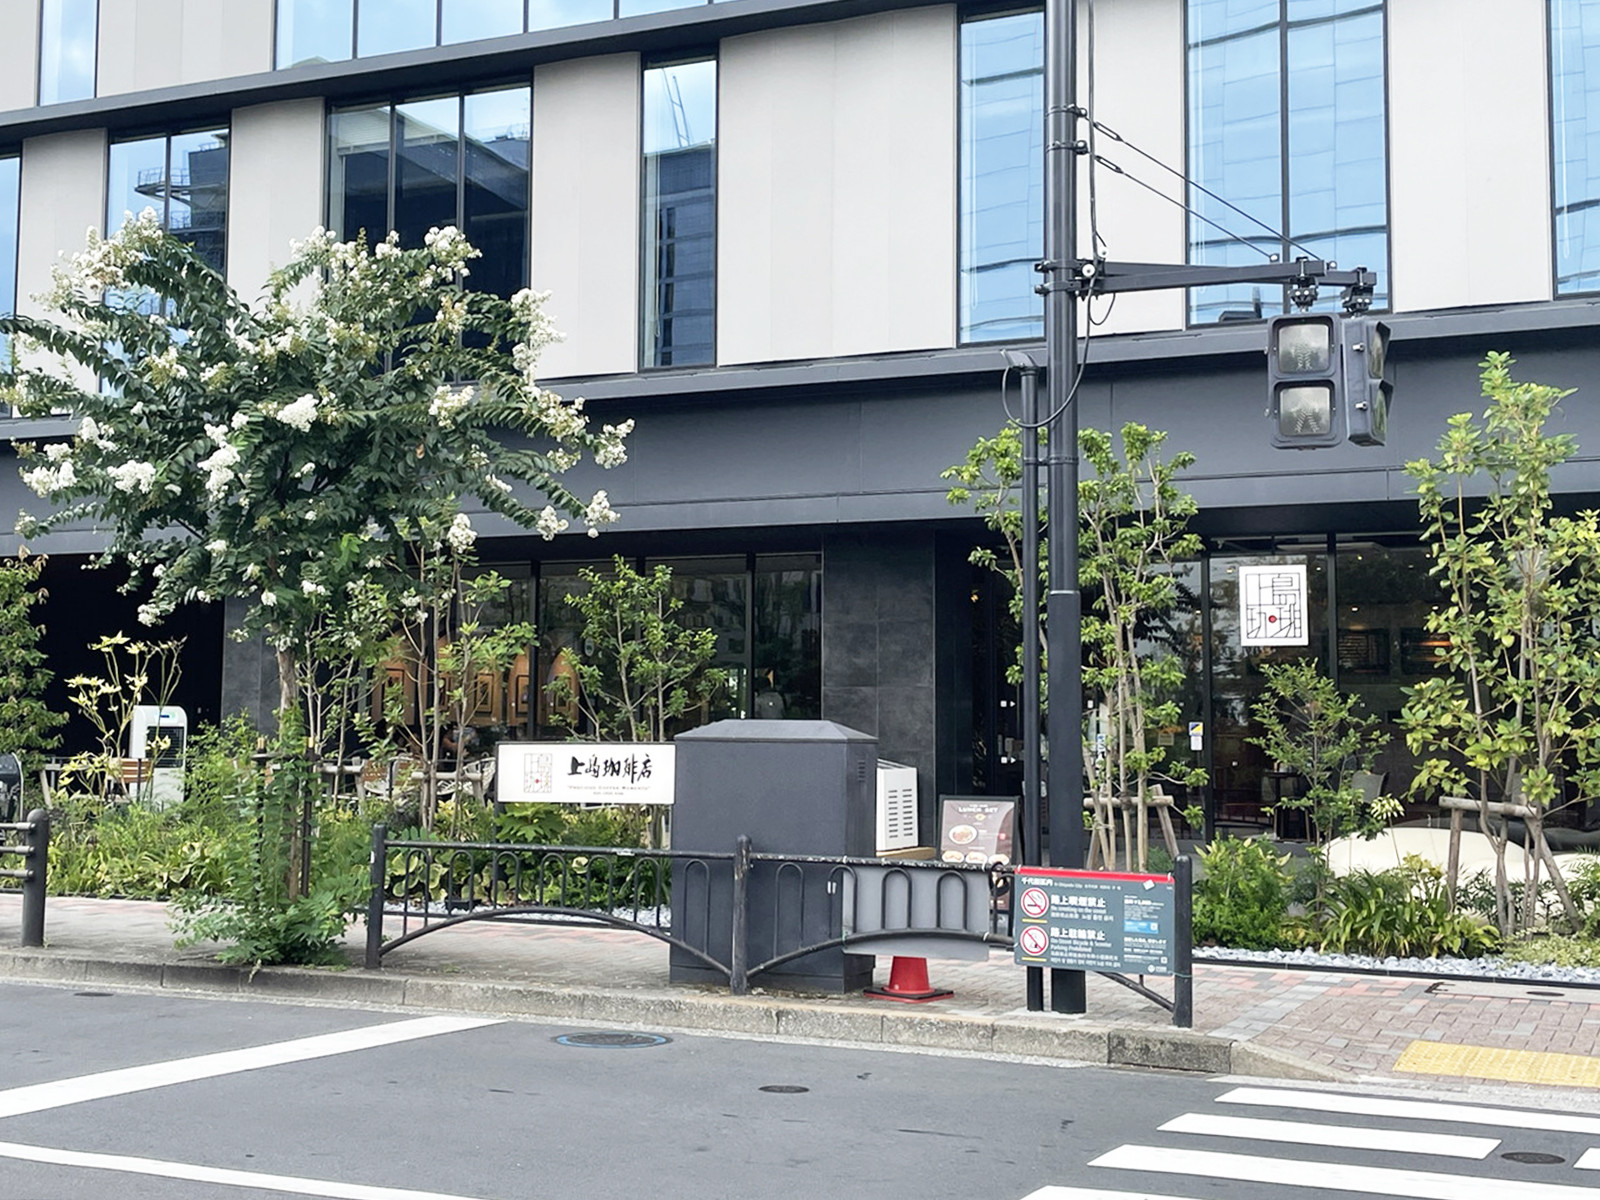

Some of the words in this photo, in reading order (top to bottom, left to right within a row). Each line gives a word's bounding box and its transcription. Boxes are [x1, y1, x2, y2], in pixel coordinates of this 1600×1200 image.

[1050, 894, 1107, 908] 路上喫煙禁止
